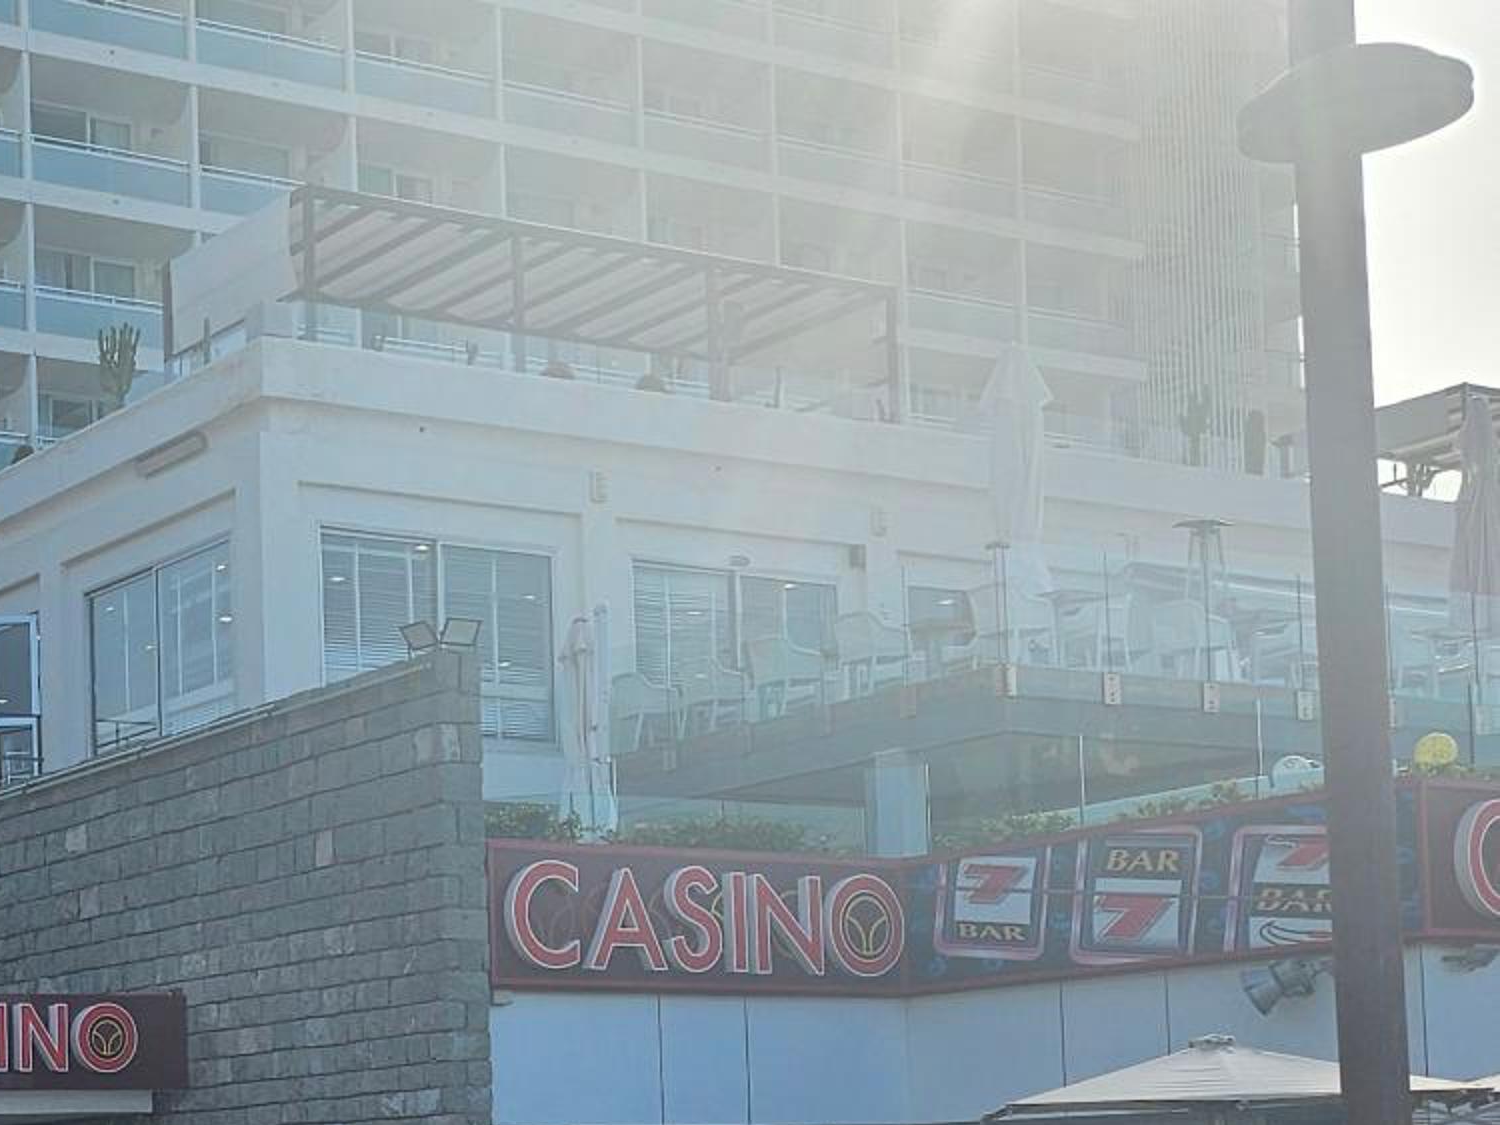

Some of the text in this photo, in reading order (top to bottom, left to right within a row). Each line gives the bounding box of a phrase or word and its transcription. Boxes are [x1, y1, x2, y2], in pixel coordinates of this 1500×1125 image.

[1108, 849, 1180, 872] BAR
[504, 859, 905, 976] CASINO
[958, 923, 1026, 941] BAR
